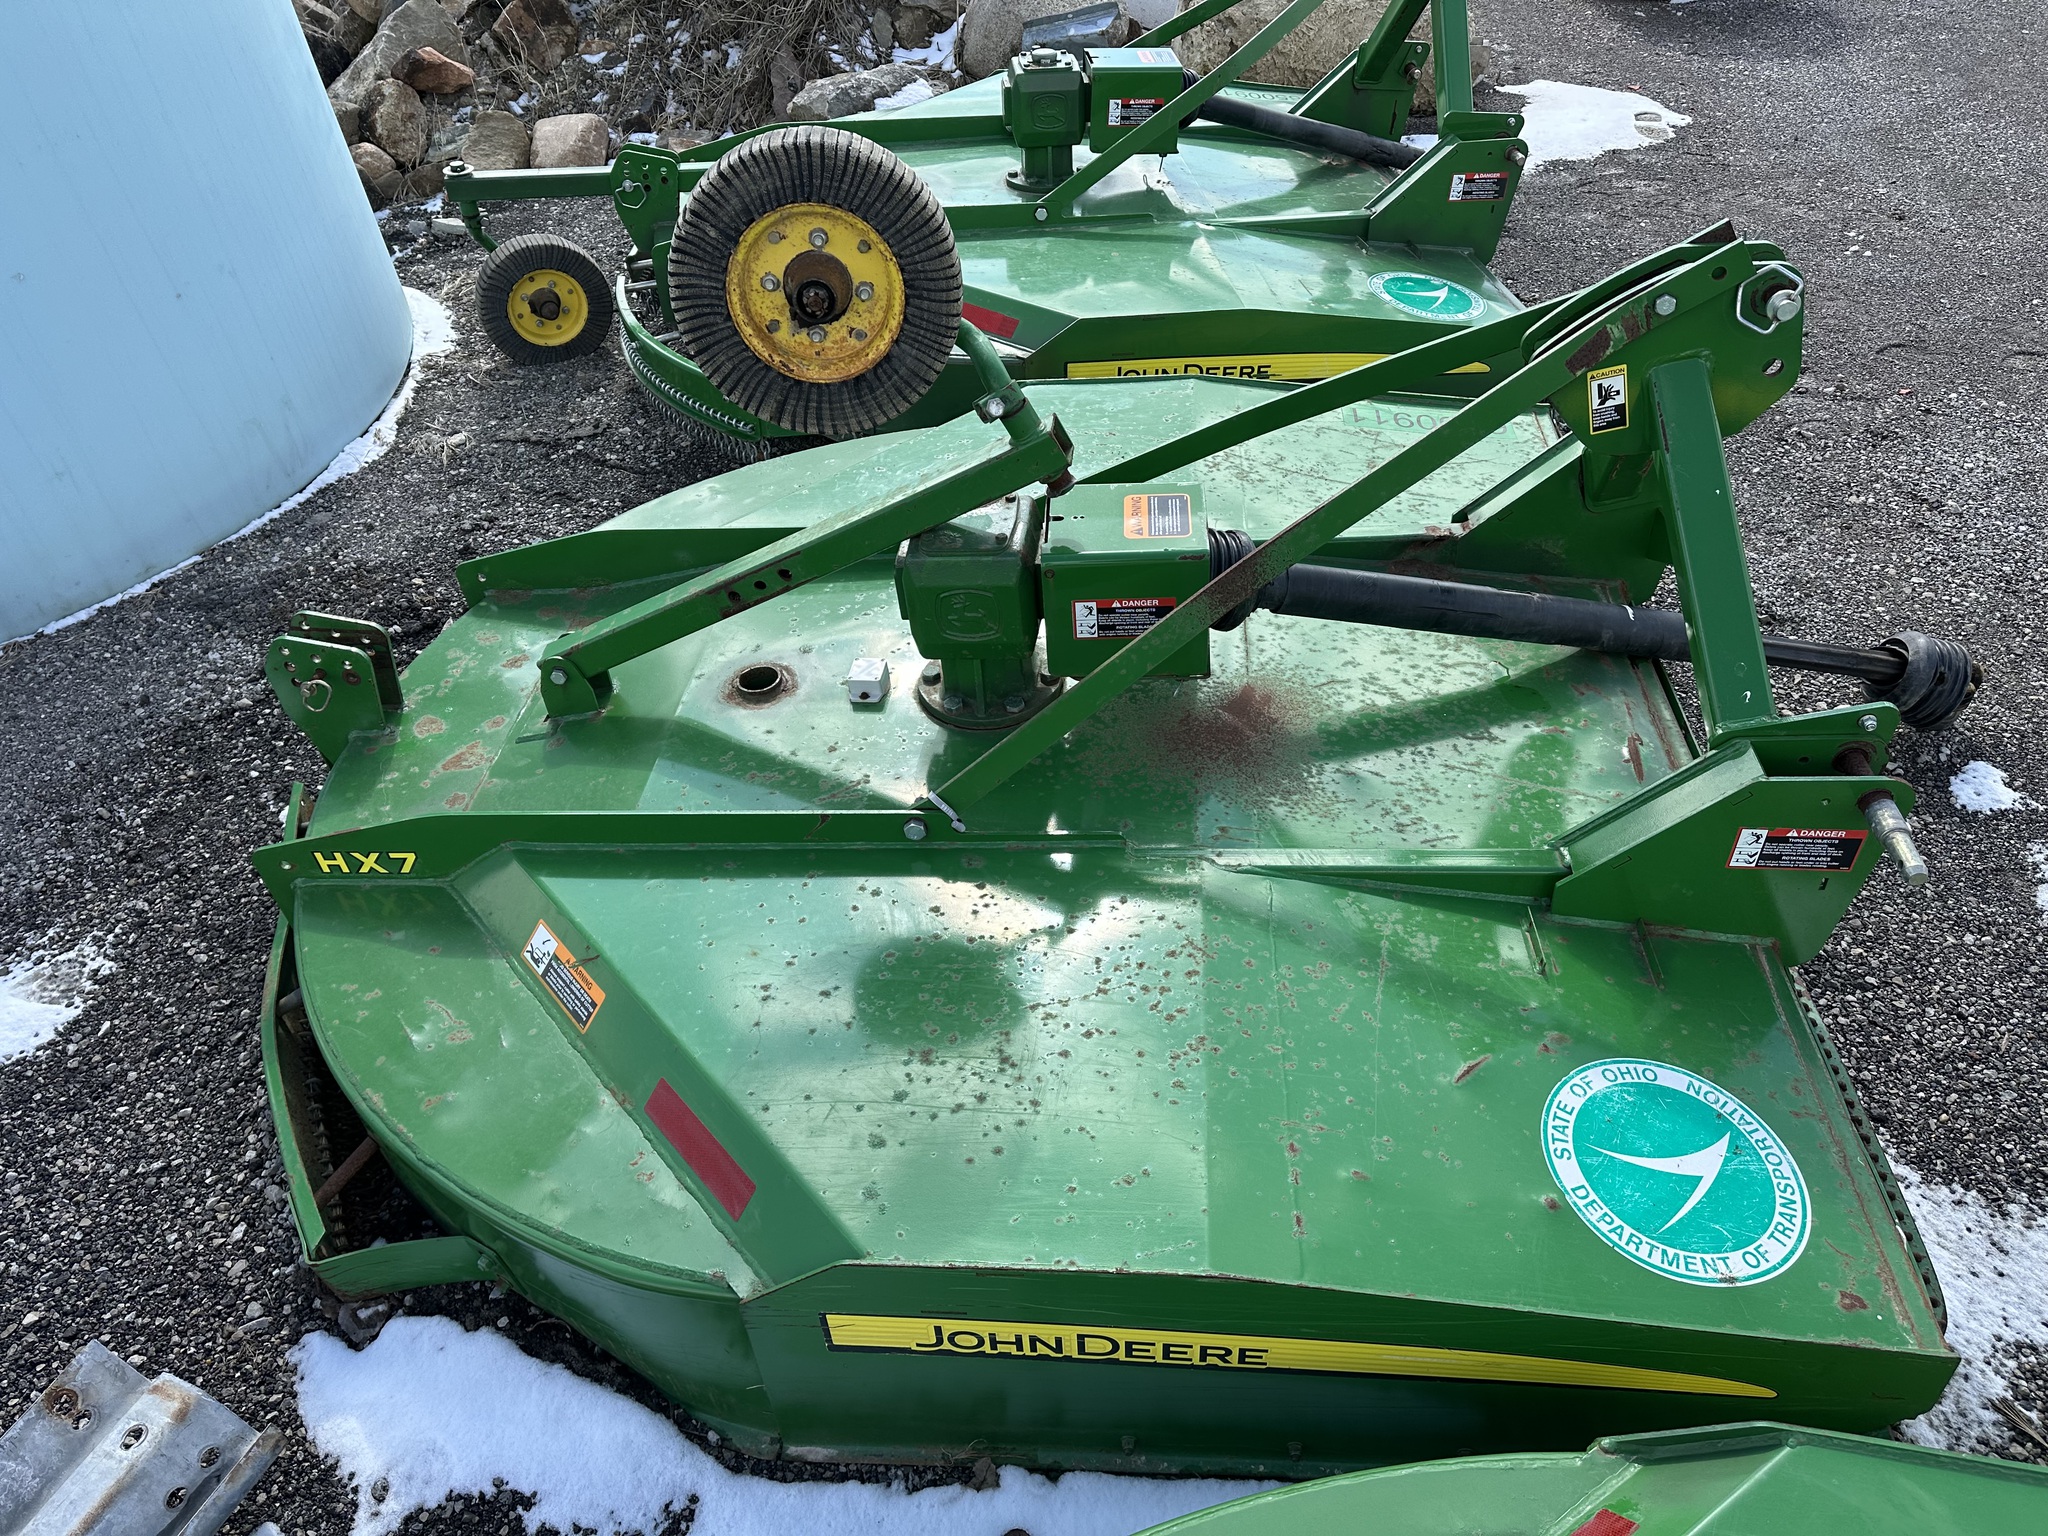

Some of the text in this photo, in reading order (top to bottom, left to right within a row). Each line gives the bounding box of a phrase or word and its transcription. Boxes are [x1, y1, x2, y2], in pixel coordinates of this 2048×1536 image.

[1595, 367, 1625, 378] CAUTION
[1122, 599, 1159, 607] DANGER
[1799, 829, 1847, 838] DANGER
[311, 850, 418, 875] HX7
[571, 964, 593, 991] ARNING
[1547, 1065, 1659, 1162] STATE OF OHIO
[1570, 1080, 1800, 1275] DEPARTMENT OF TRANSPORTATION
[915, 1325, 1270, 1366] JOHN DEERE
